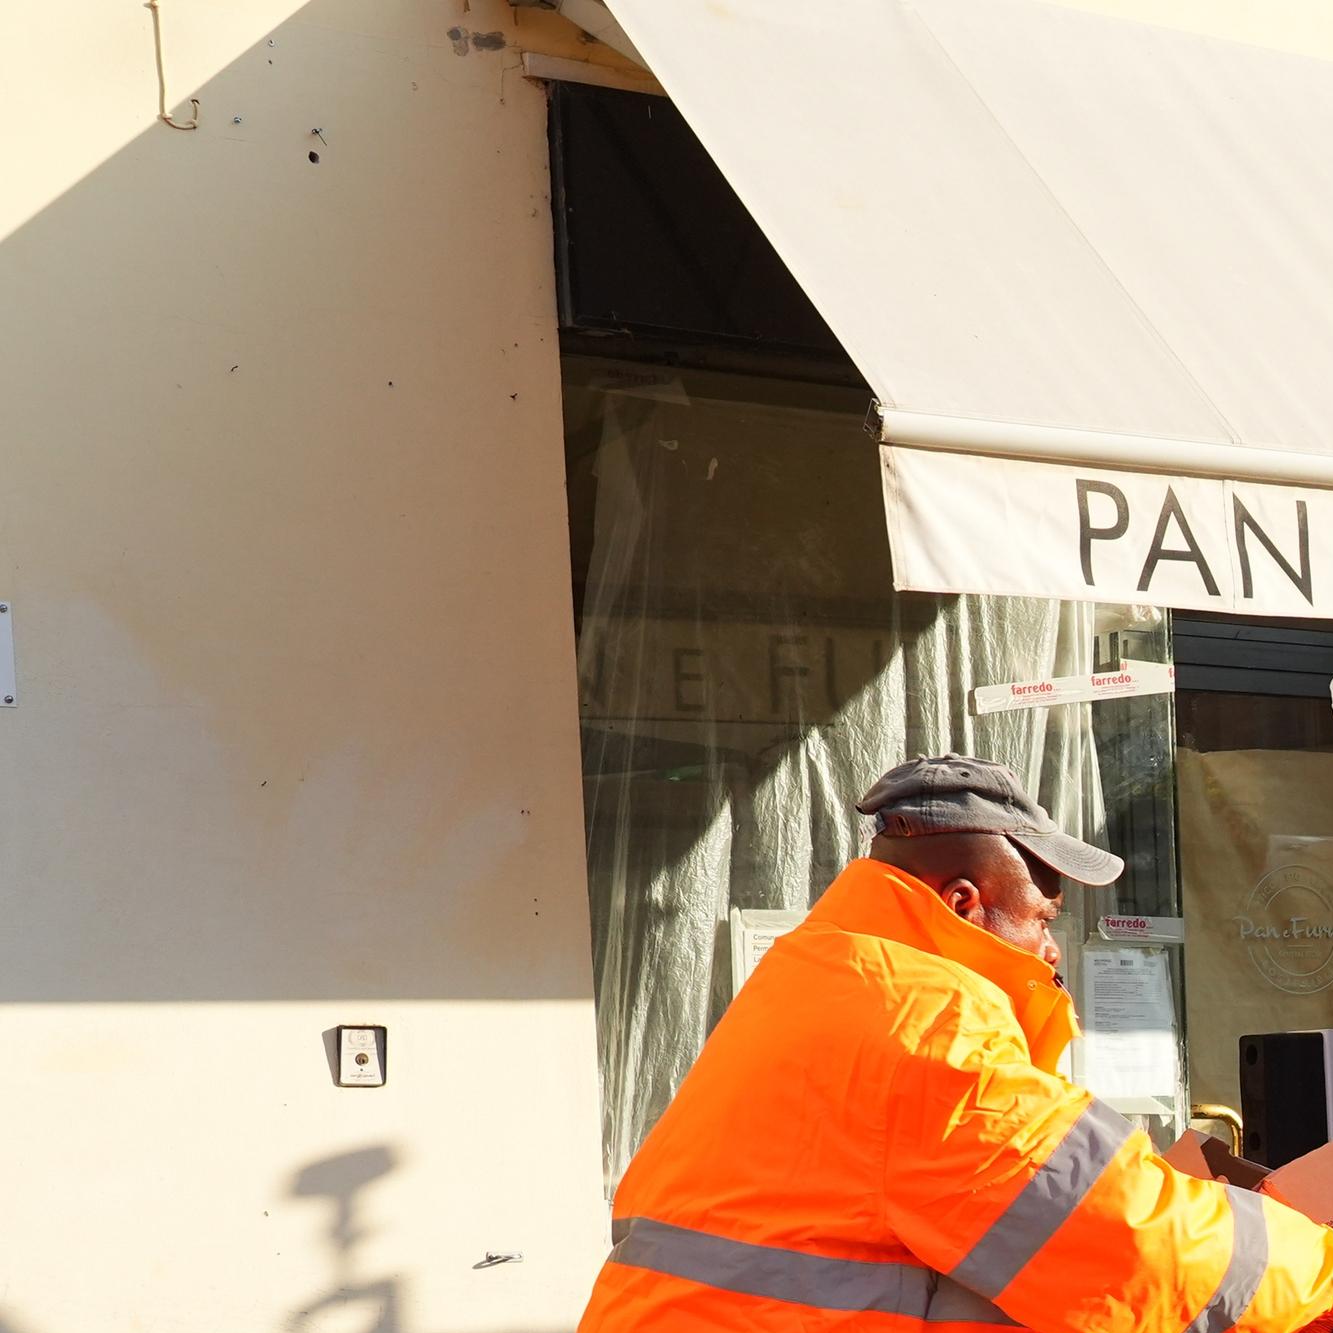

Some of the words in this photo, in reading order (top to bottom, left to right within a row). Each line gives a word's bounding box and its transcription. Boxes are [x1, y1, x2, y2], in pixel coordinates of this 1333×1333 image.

[1075, 479, 1313, 607] PAN
[1091, 673, 1132, 687] farredo
[1011, 682, 1053, 696] farredo
